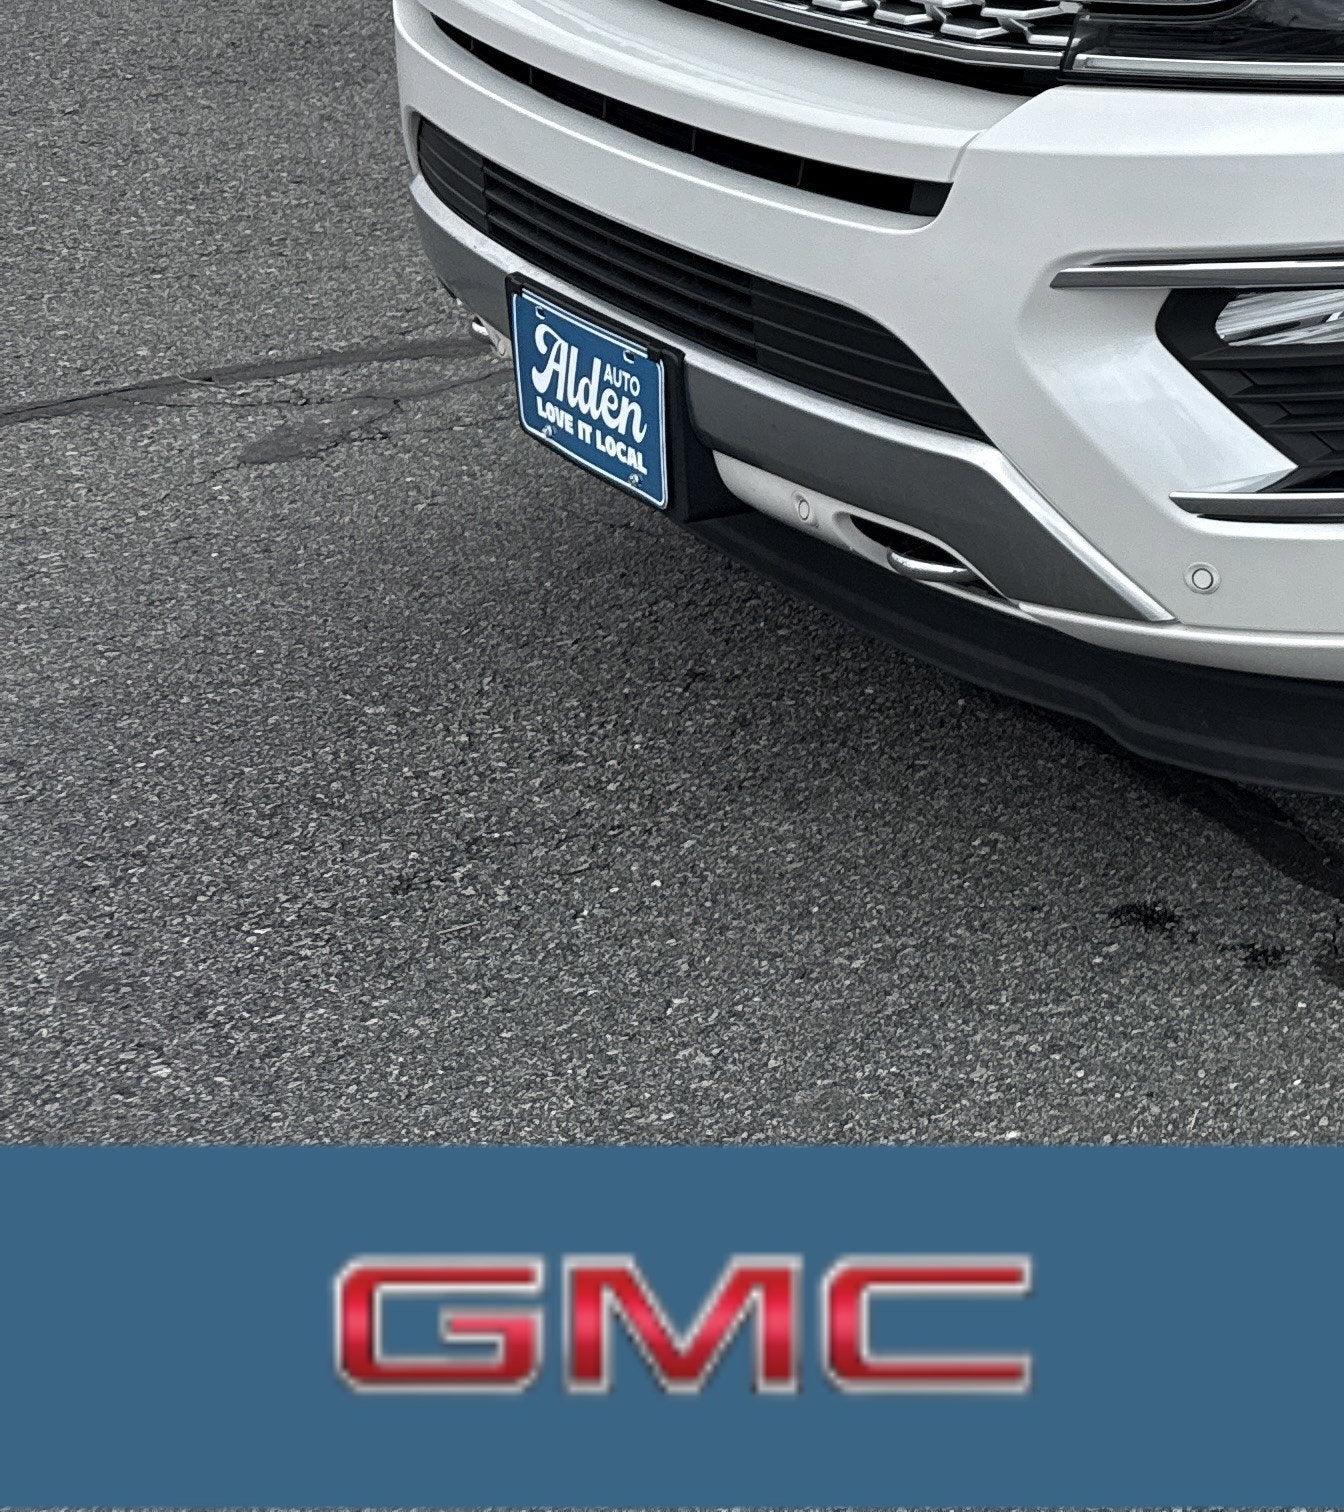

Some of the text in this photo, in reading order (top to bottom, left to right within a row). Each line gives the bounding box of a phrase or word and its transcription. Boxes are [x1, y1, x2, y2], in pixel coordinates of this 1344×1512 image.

[531, 323, 648, 443] Alden
[603, 363, 641, 397] AUTO
[536, 395, 648, 475] LOVE IT LOCAL
